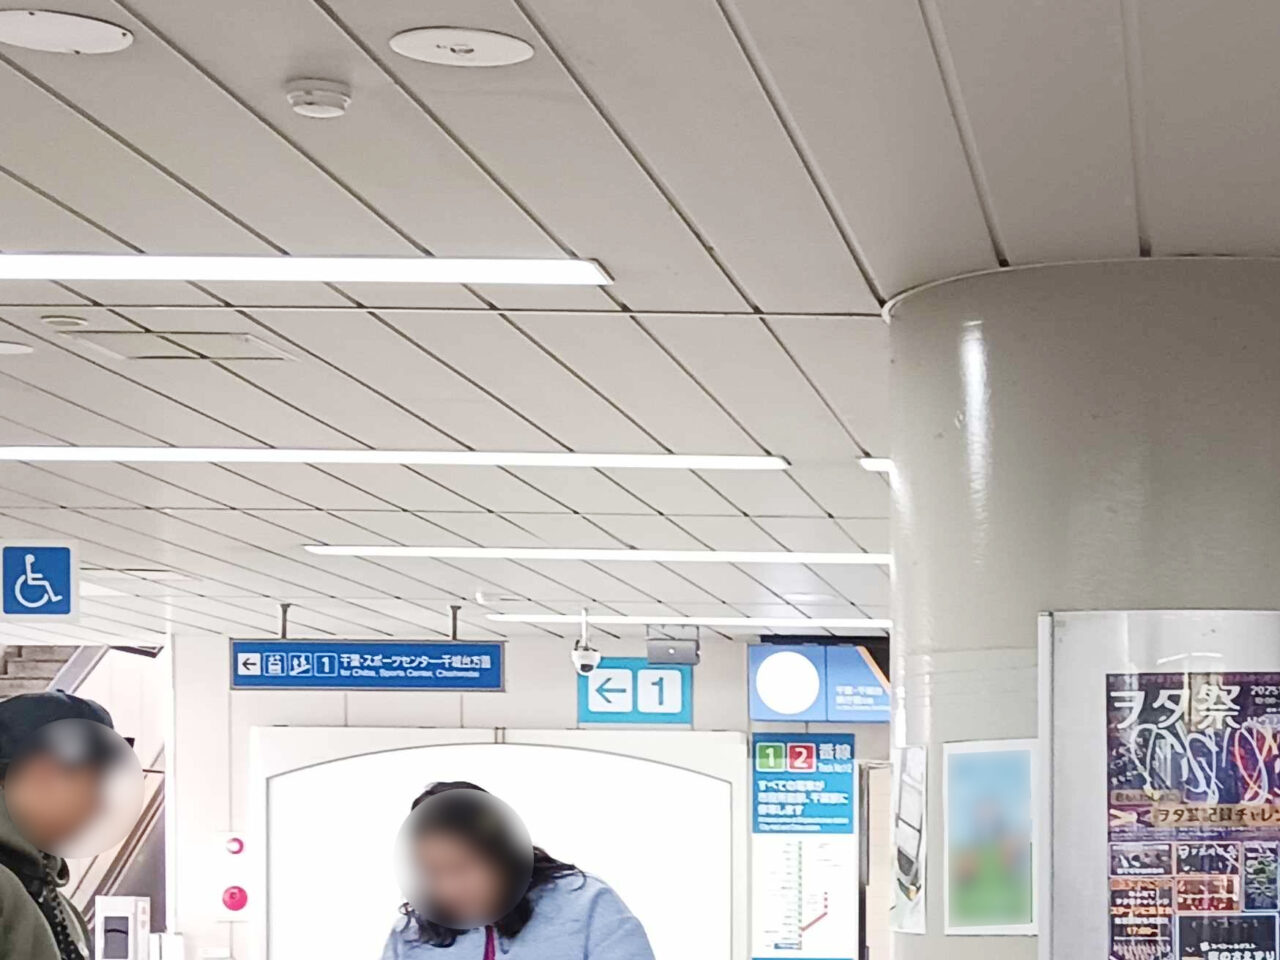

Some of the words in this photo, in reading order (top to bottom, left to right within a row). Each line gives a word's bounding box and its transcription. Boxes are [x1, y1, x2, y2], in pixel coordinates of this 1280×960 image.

[321, 656, 330, 674] 1
[651, 677, 663, 706] 1
[1109, 684, 1242, 729] ヲタ祭
[765, 747, 775, 768] 1
[793, 747, 809, 768] 2
